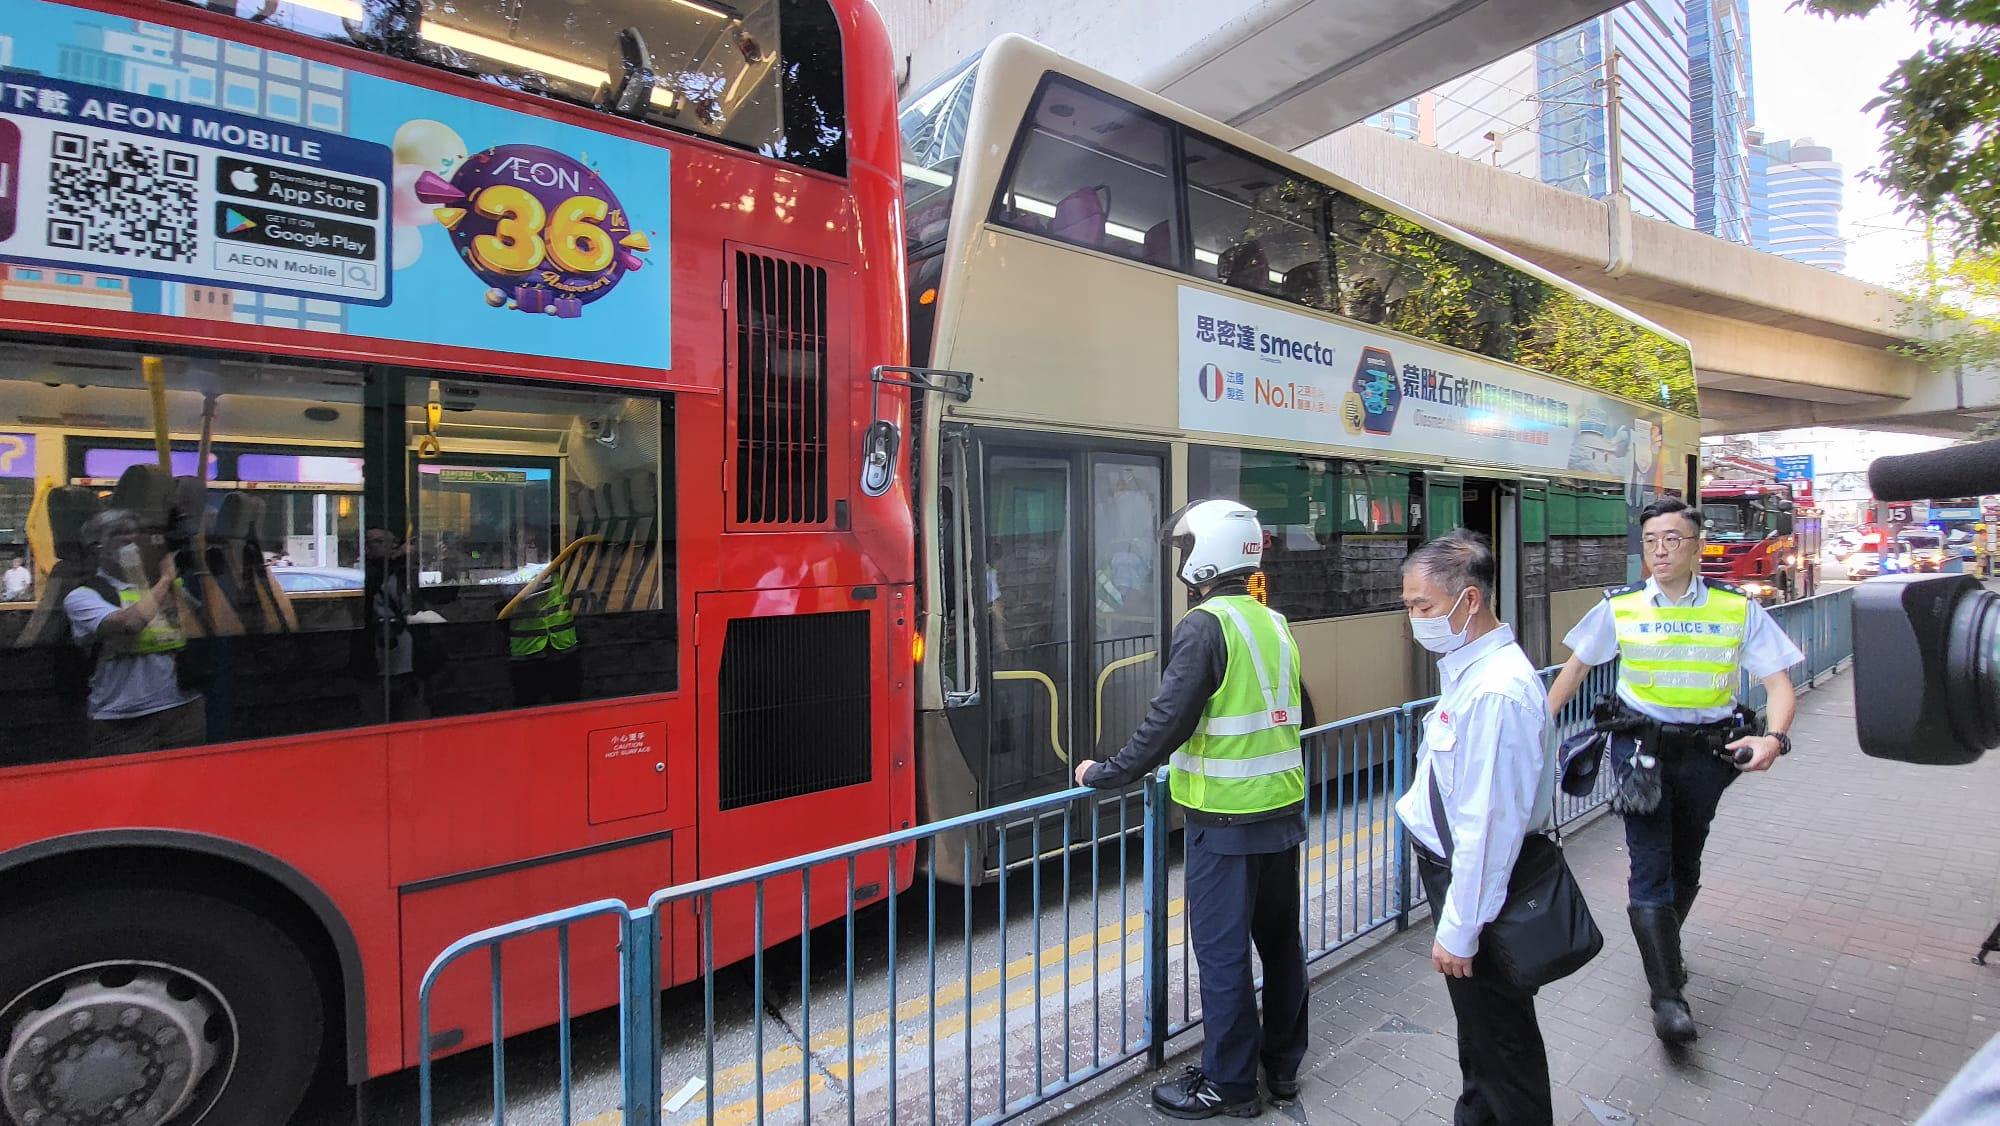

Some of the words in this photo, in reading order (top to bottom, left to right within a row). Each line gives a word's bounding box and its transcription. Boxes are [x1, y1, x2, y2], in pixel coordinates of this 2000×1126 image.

[0, 82, 71, 116] 下載
[79, 98, 181, 134] AEON
[192, 118, 321, 161] MOBILE
[268, 182, 311, 204] App
[314, 191, 367, 212] Store
[269, 171, 328, 190] Download
[329, 183, 344, 192] on
[347, 184, 366, 196] the
[265, 214, 285, 225] GET
[287, 217, 296, 226] IT
[299, 219, 315, 229] ON
[471, 184, 614, 275] 36
[265, 225, 329, 248] Google
[332, 235, 367, 255] Play
[228, 253, 279, 269] AEON
[284, 261, 337, 278] Mobile
[1196, 315, 1256, 352] 思密達
[1260, 333, 1333, 367] smecta
[1255, 376, 1296, 409] No.1
[1655, 622, 1703, 634] POLICE
[620, 746, 651, 755] SURFACE
